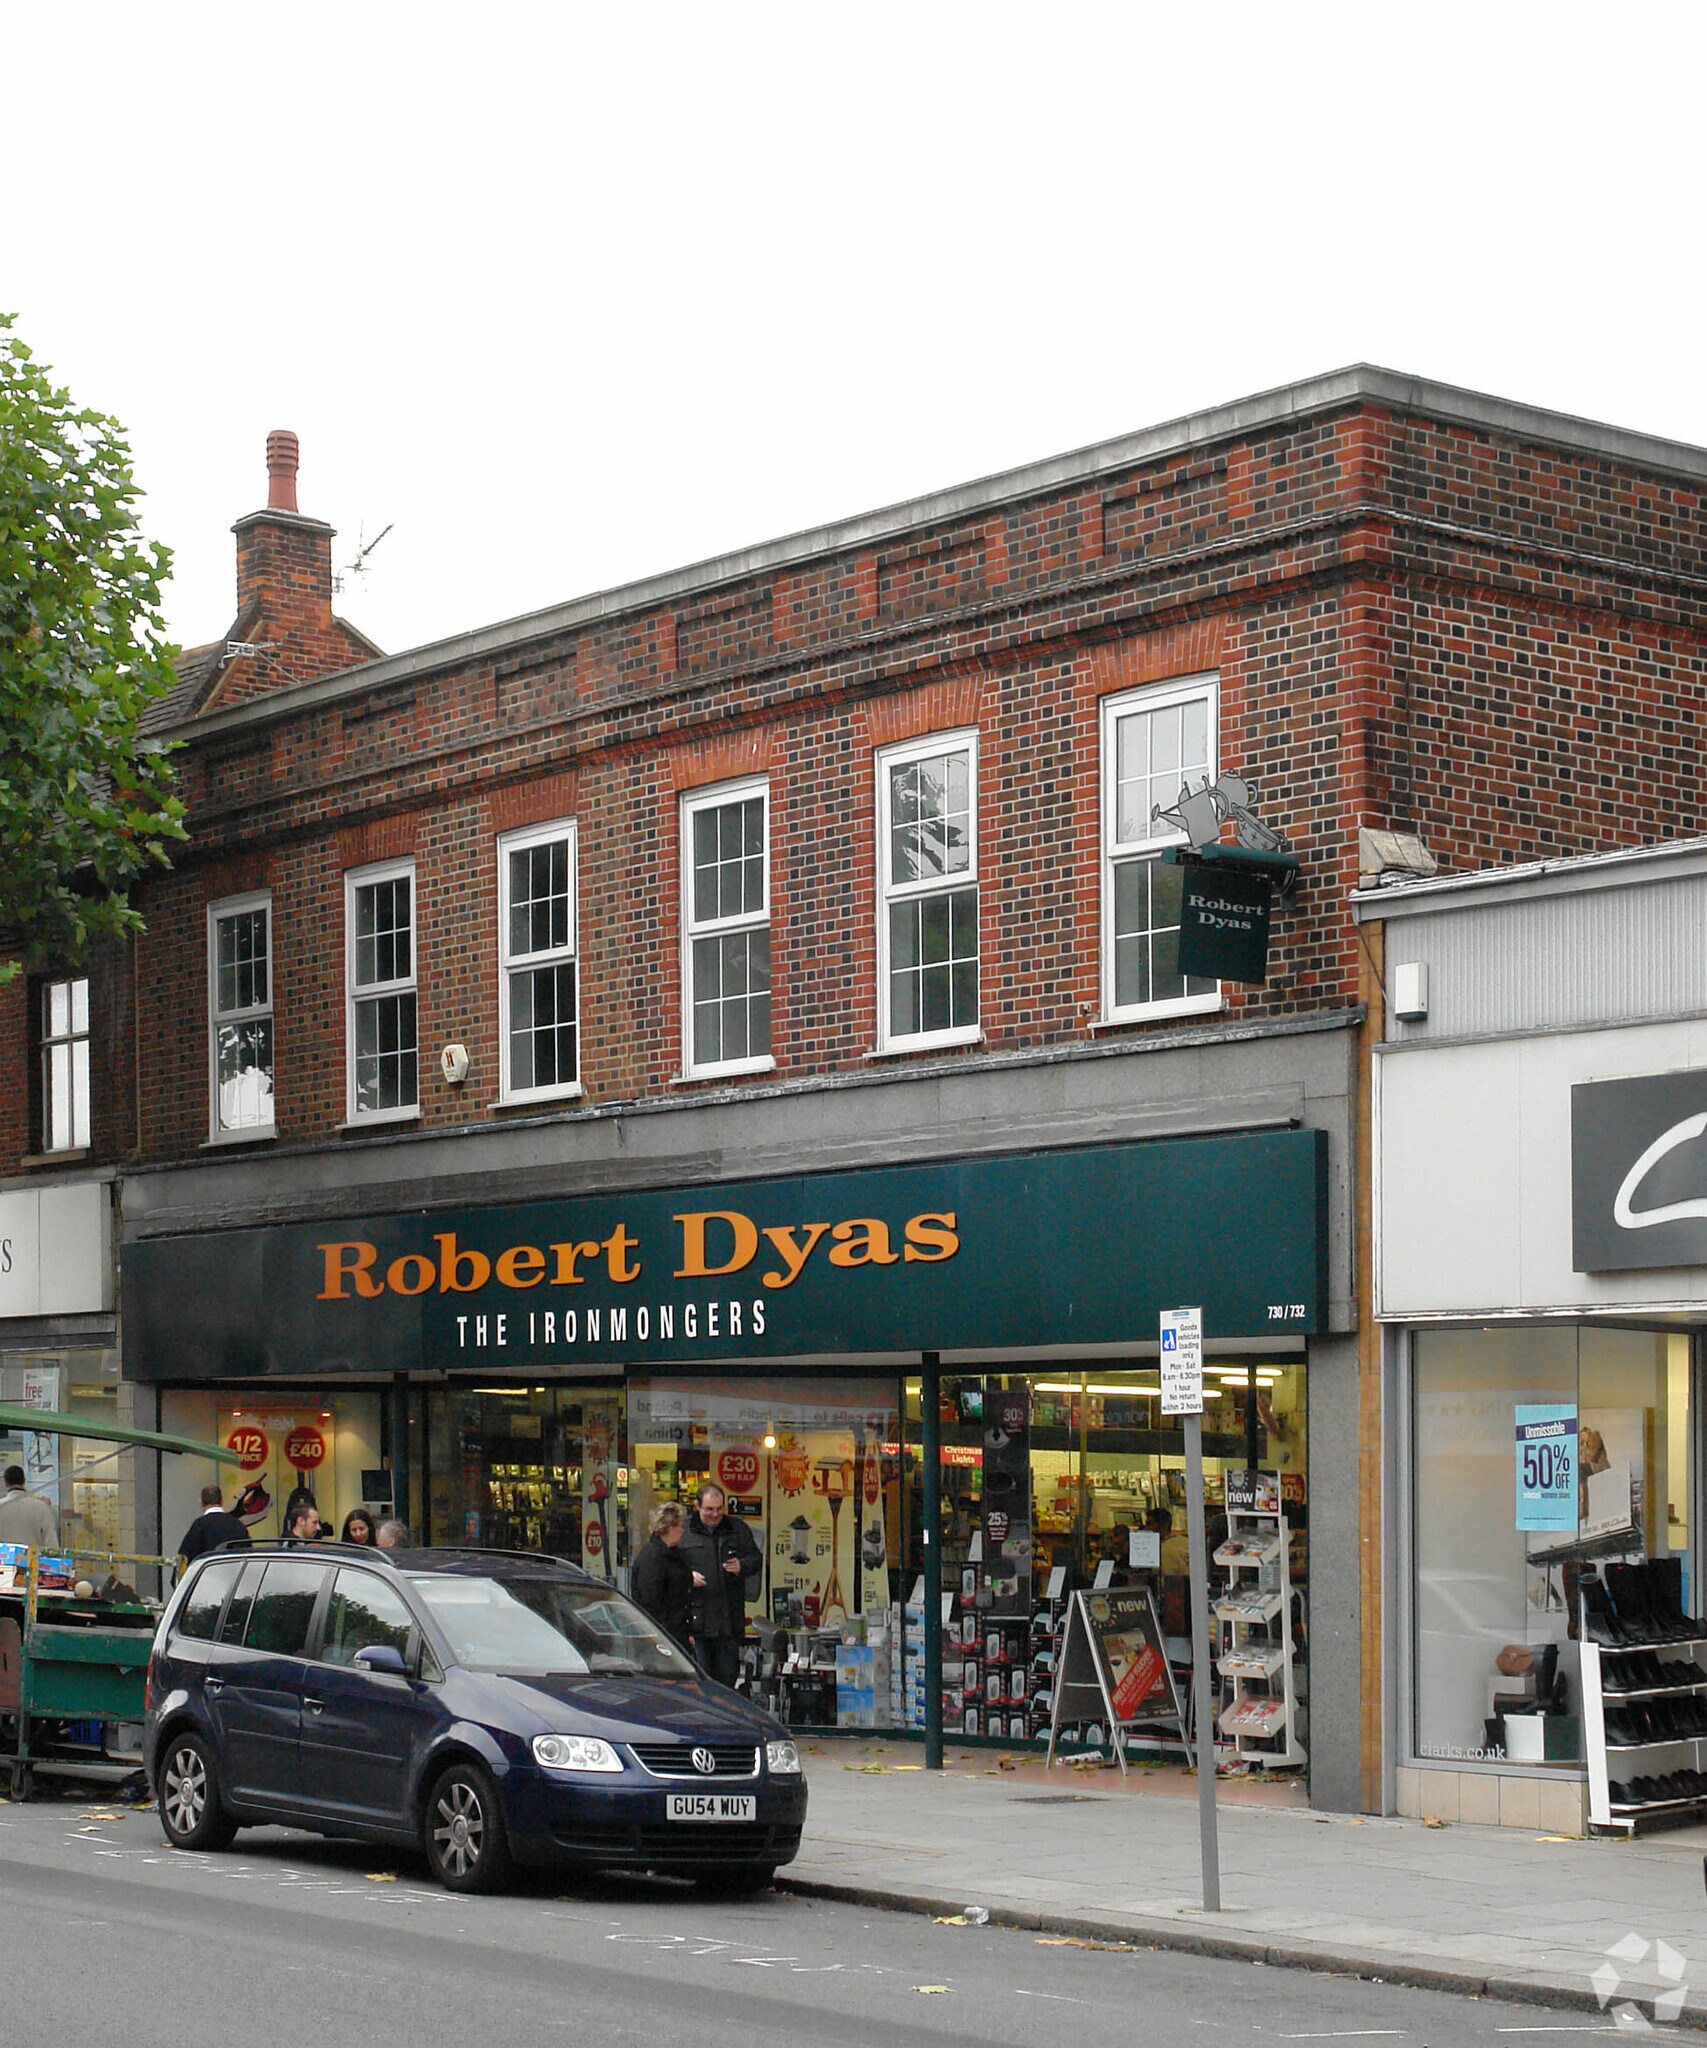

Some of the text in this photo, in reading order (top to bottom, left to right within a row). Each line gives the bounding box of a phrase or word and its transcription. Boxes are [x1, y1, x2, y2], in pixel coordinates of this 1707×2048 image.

[1187, 894, 1265, 916] Robert
[1198, 911, 1252, 930] Dyas
[316, 1210, 960, 1300] Robert Dyas
[1267, 1305, 1284, 1319] 730
[1289, 1304, 1306, 1318] 732
[456, 1299, 766, 1347] THE IRONMONGERS
[1180, 1323, 1197, 1331] Goods
[1178, 1332, 1200, 1341] vehicles
[1179, 1341, 1199, 1350] loading
[1182, 1350, 1194, 1359] only
[25, 1382, 42, 1398] free
[1525, 1421, 1566, 1439] Unmissable
[233, 1435, 262, 1453] 1/2
[290, 1443, 322, 1457] £40
[944, 1445, 983, 1454] Christmas
[722, 1455, 756, 1472] £30
[951, 1455, 976, 1465] Lights
[1523, 1444, 1570, 1489] 50% OFF
[1228, 1491, 1253, 1503] new
[588, 1535, 601, 1548] £10
[1117, 1599, 1148, 1613] new
[1420, 1741, 1505, 1760] clarks.co.uk
[674, 1797, 750, 1816] GU54 WUY
